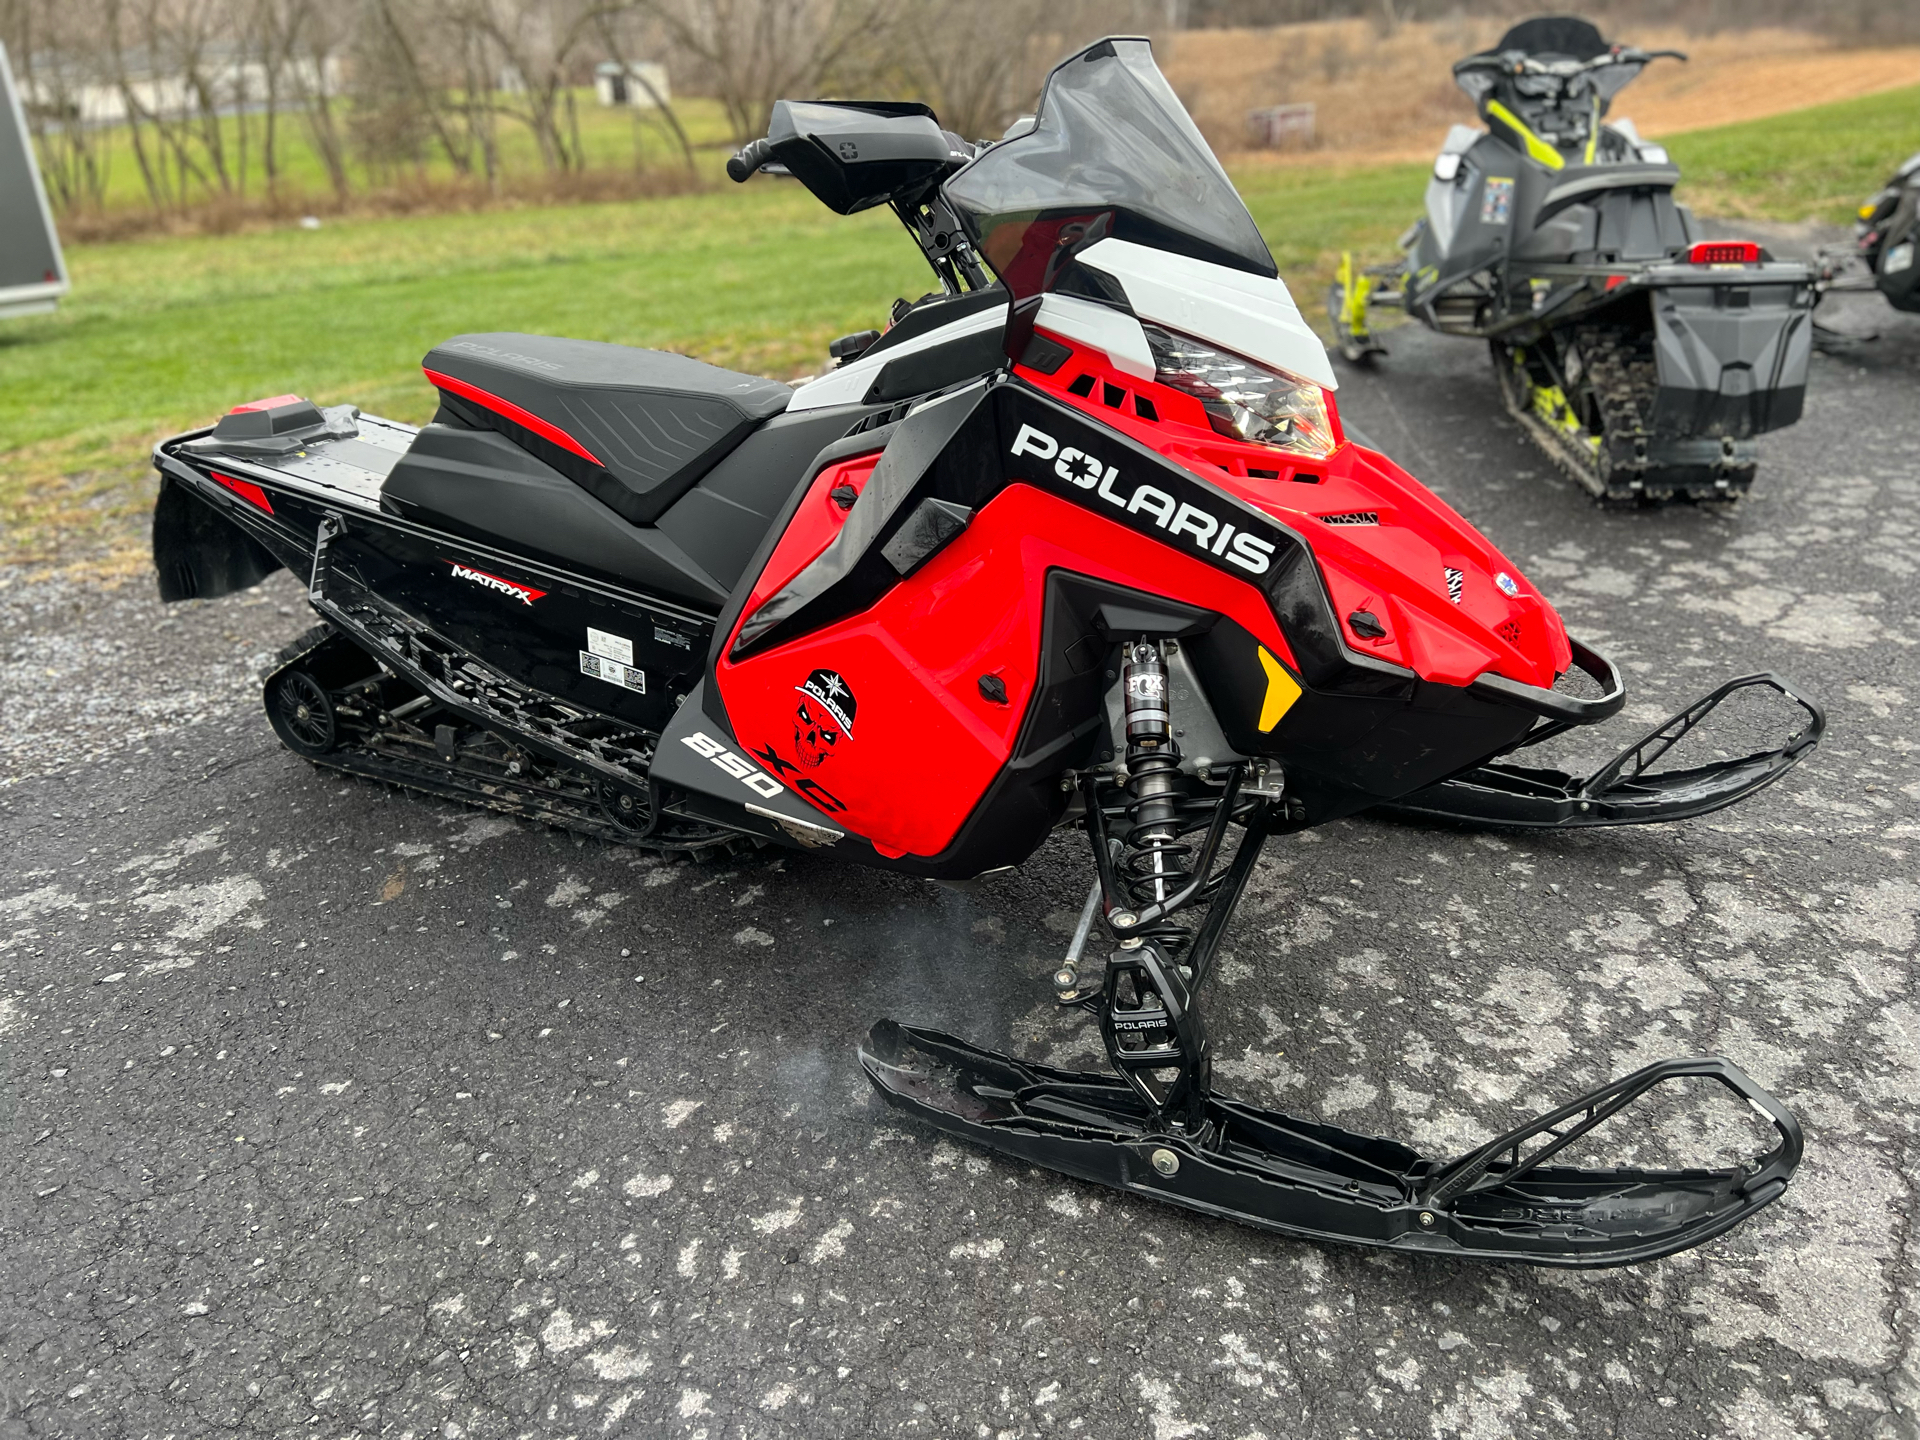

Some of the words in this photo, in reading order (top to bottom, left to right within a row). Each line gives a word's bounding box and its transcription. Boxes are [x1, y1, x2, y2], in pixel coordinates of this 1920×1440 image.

[1010, 422, 1276, 575] POLARIS
[451, 564, 533, 607] MATRYX
[804, 680, 853, 730] POLARIS
[1128, 673, 1164, 701] FOX
[680, 731, 785, 799] 850
[749, 741, 848, 813] XC
[1113, 1019, 1168, 1031] POLARIS
[1444, 1154, 1493, 1194] POLARIS
